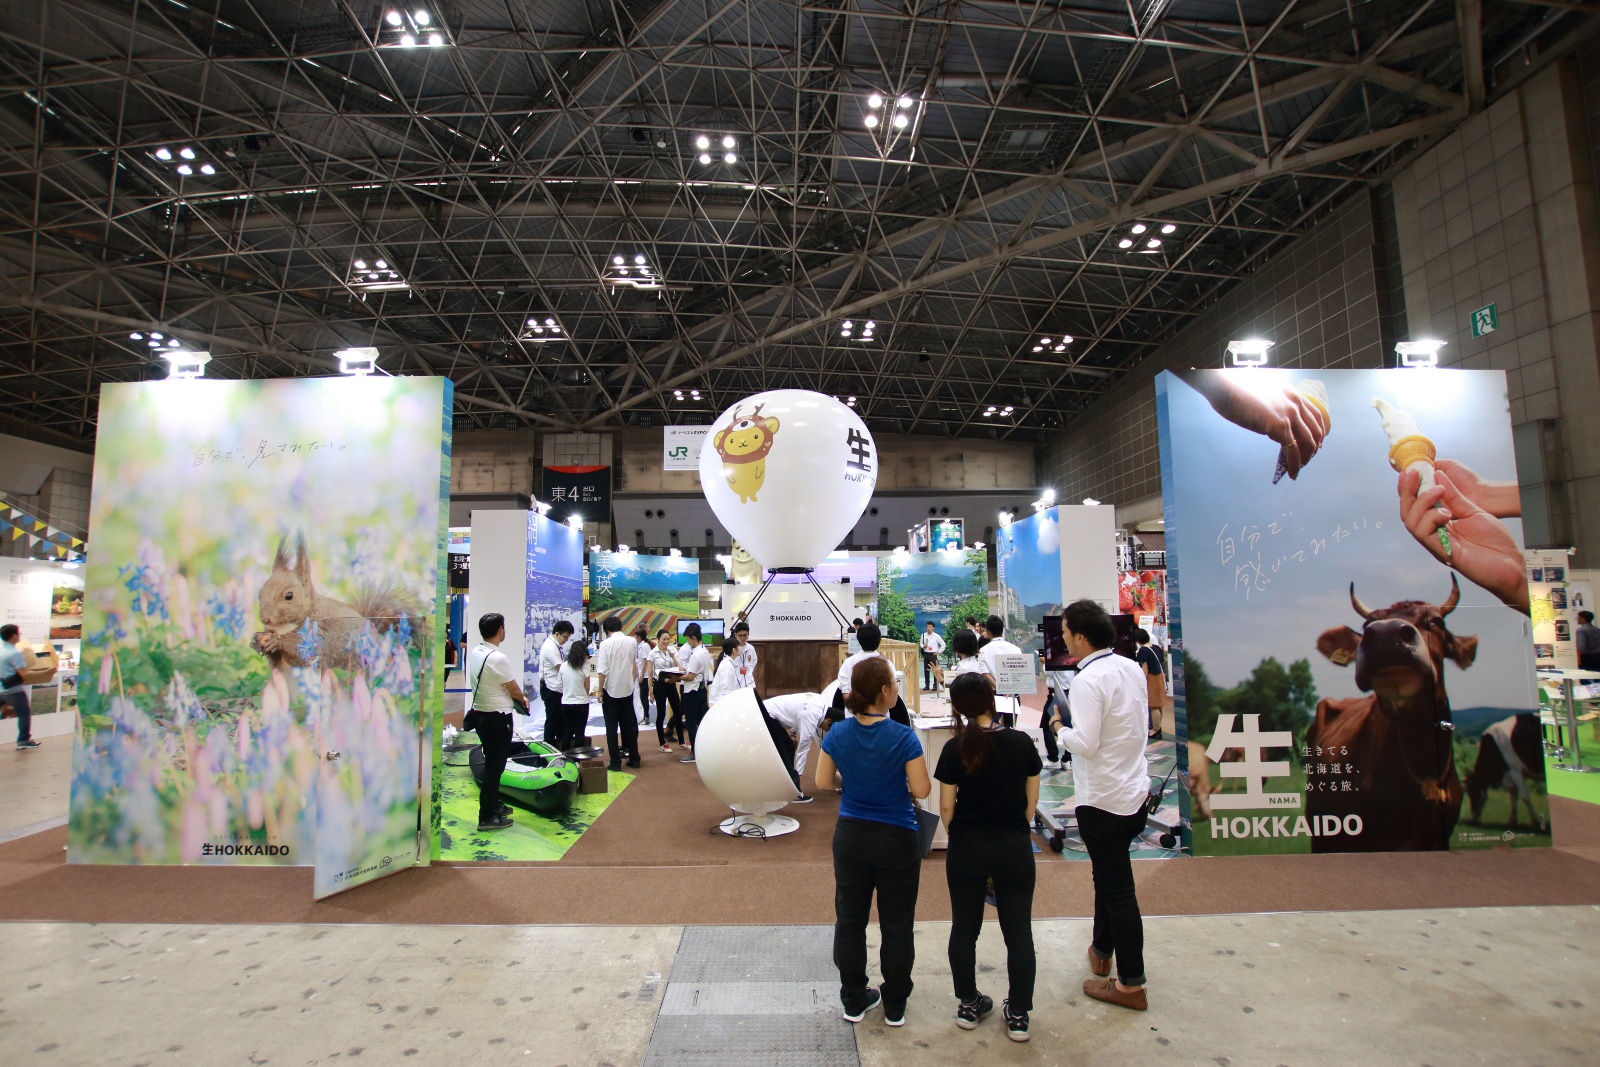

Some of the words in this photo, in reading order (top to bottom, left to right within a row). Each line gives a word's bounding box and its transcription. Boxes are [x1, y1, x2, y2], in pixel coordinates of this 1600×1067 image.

[668, 446, 689, 458] JR
[1216, 511, 1304, 567] 自分で、
[1234, 518, 1383, 602] 感じてみたい。
[596, 553, 613, 596] 美瑛
[1301, 745, 1349, 757] 生きてる
[1205, 713, 1302, 810] 生
[1302, 763, 1361, 775] 北海道を、
[1304, 780, 1360, 792] めぐる旅。
[1269, 797, 1298, 805] NAMA
[1210, 814, 1364, 839] HOKKAIDO
[201, 841, 290, 857] 生HOKKAIDO
